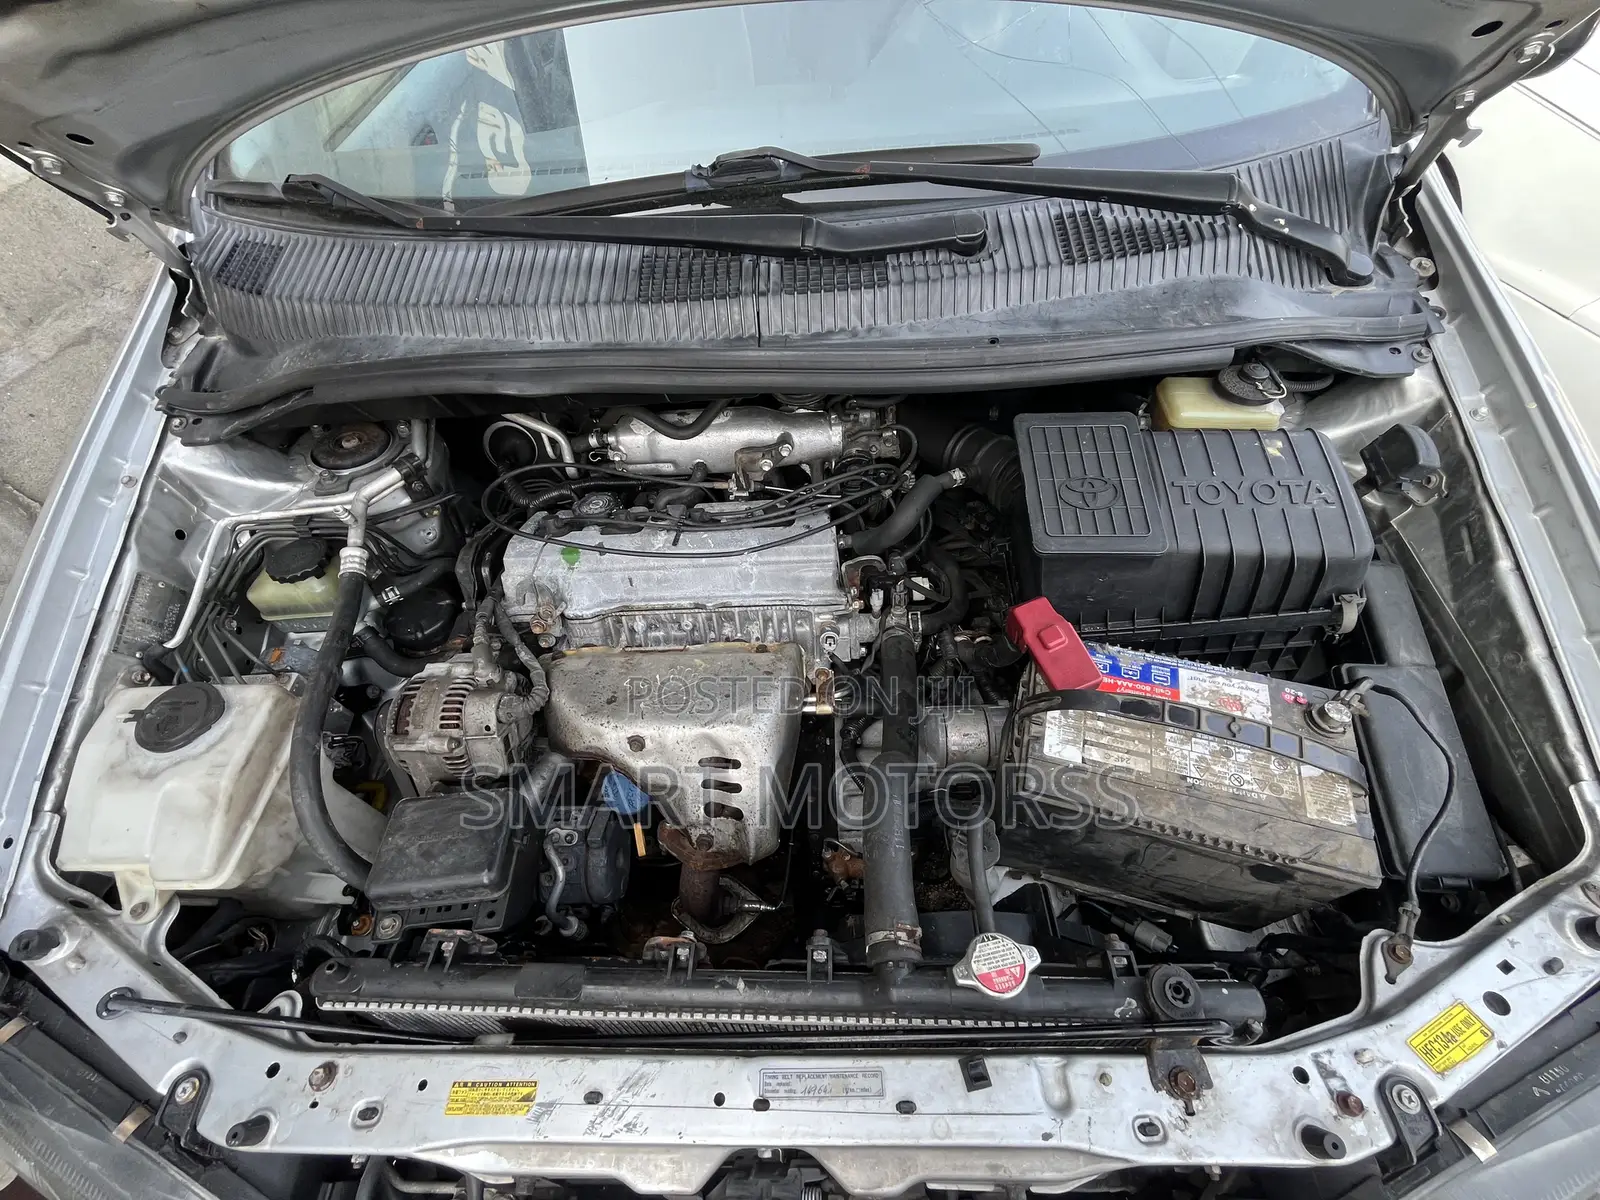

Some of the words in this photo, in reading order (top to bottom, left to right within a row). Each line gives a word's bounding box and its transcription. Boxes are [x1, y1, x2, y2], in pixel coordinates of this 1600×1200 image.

[1173, 479, 1337, 506] TOYOTA
[1208, 679, 1221, 687] can
[1222, 682, 1237, 690] you
[1418, 1031, 1459, 1063] HFC134a
[1450, 1023, 1467, 1037] USE
[1460, 1014, 1477, 1030] ONLY
